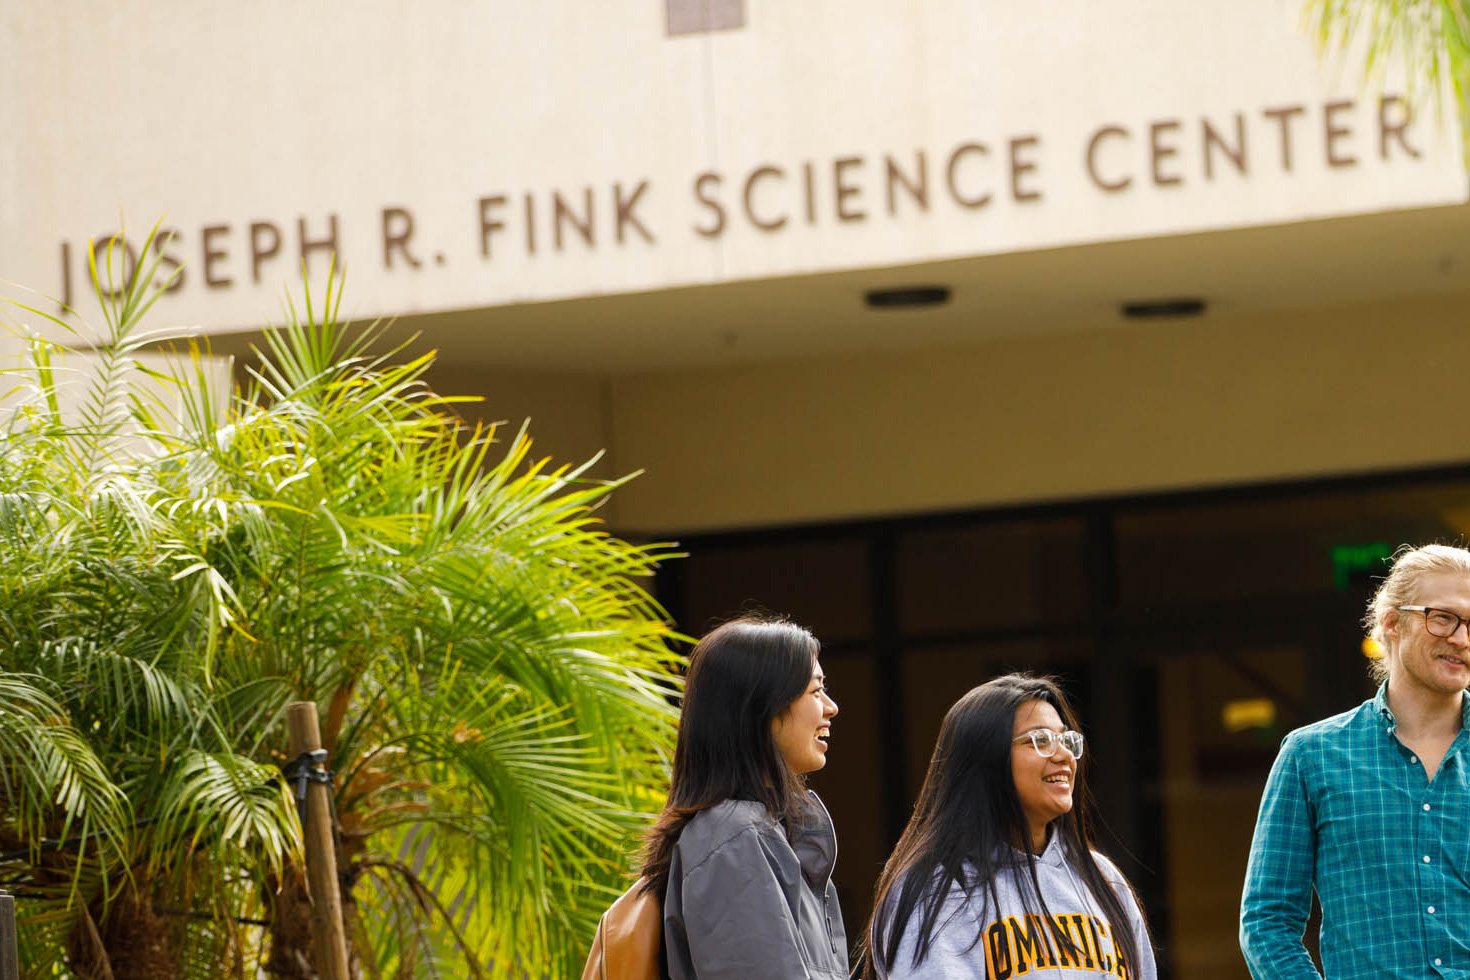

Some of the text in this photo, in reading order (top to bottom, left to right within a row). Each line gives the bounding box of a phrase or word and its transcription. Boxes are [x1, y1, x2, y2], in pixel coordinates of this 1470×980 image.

[58, 93, 1422, 314] JOSEPH R. FINK SCIENCE CENTER
